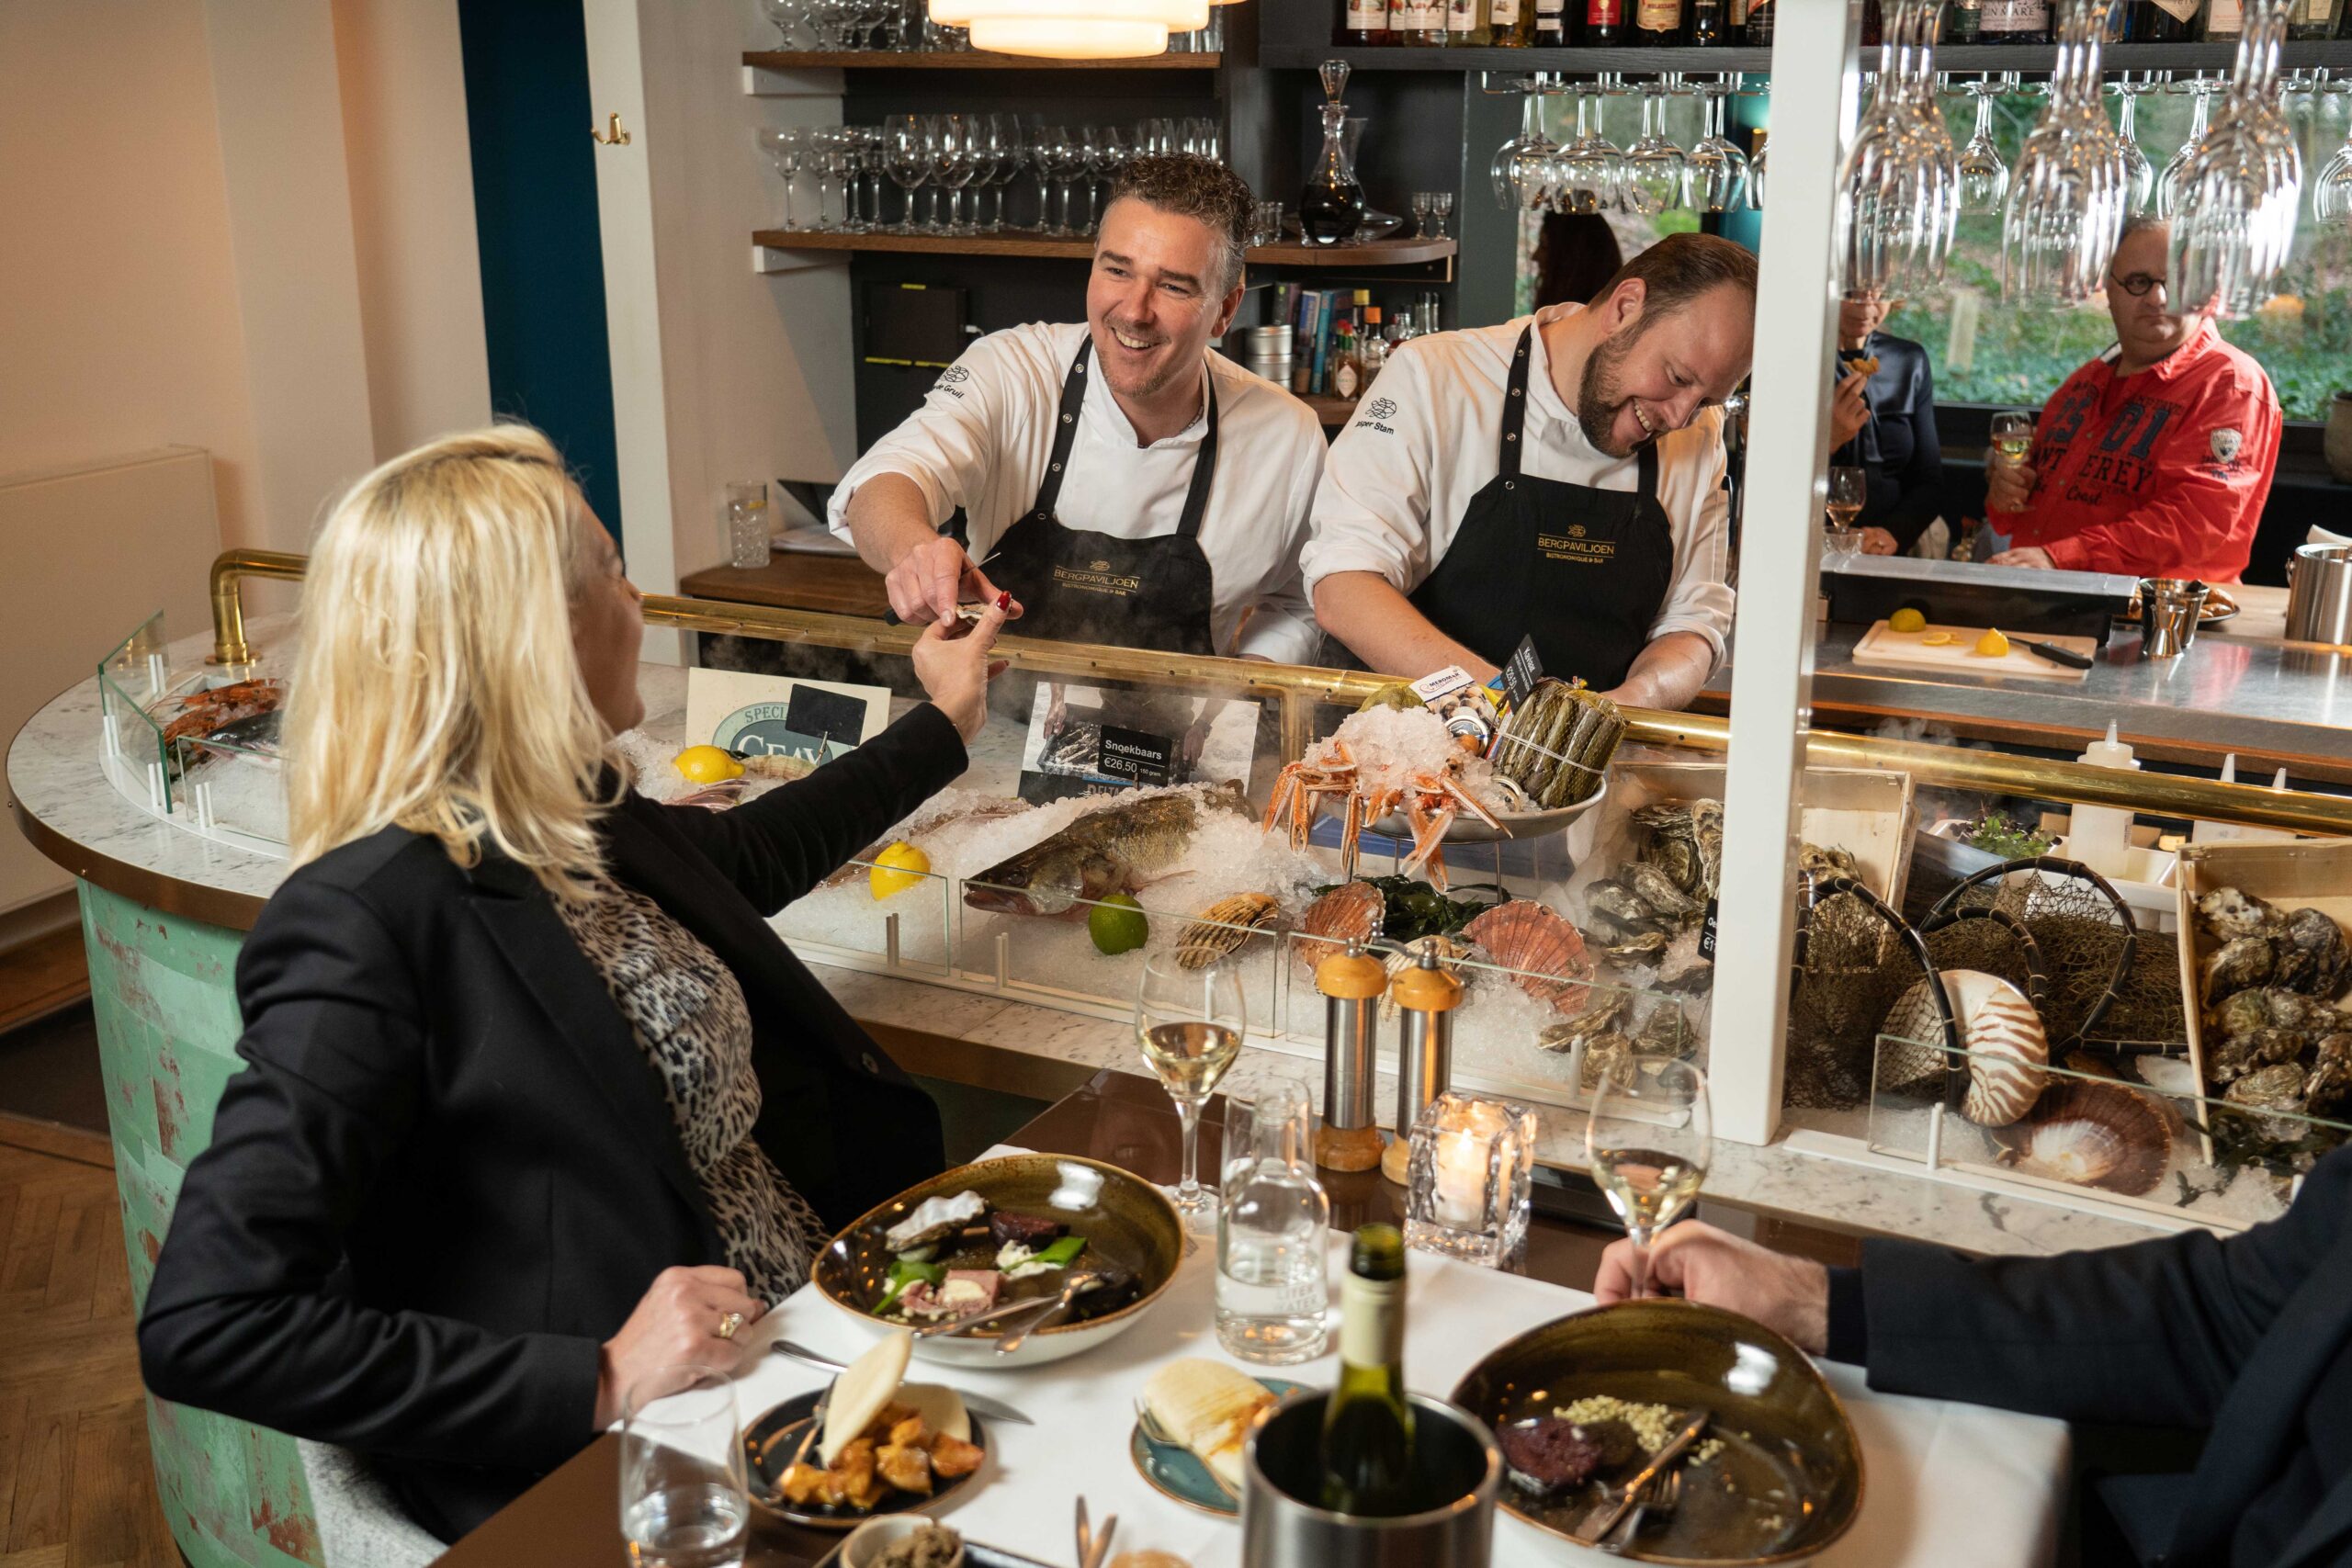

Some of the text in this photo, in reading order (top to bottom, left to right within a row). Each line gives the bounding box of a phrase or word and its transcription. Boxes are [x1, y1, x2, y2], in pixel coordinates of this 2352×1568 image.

[1374, 422, 1394, 434] Stam
[1538, 537, 1614, 555] BERGPAVILJOEN
[1054, 569, 1139, 589] BERGPAVILJOEN
[745, 706, 788, 723] SPECI
[1104, 739, 1162, 761] Snoekbaars
[1103, 757, 1137, 773] €26,50
[1703, 936, 1715, 952] €1
